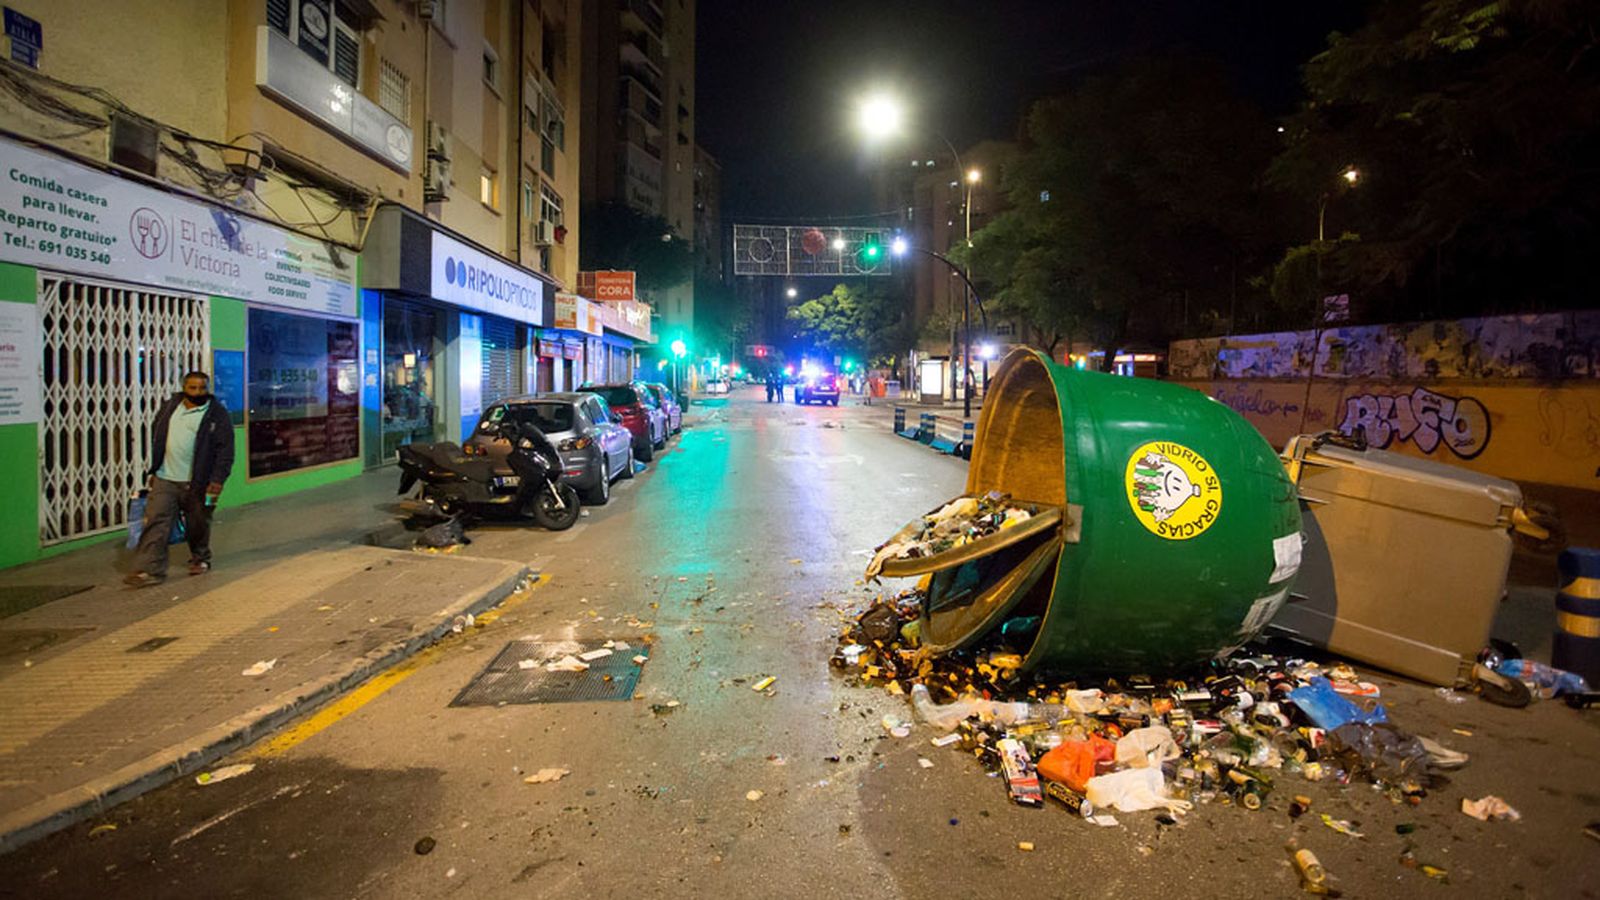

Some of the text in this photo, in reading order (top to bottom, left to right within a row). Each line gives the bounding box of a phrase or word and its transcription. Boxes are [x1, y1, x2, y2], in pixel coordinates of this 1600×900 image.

[9, 168, 108, 207] Comida casera
[0, 208, 57, 233] Reparto
[23, 195, 100, 224] para llevar.
[4, 232, 112, 265] Tel.: 691 035 540
[181, 219, 197, 243] El
[256, 240, 268, 260] la
[180, 245, 241, 278] Victoria
[268, 286, 285, 296] FOOD
[598, 285, 632, 296] CORA
[1155, 443, 1208, 472] VIDRIO
[1157, 499, 1219, 537] GRACIAS
